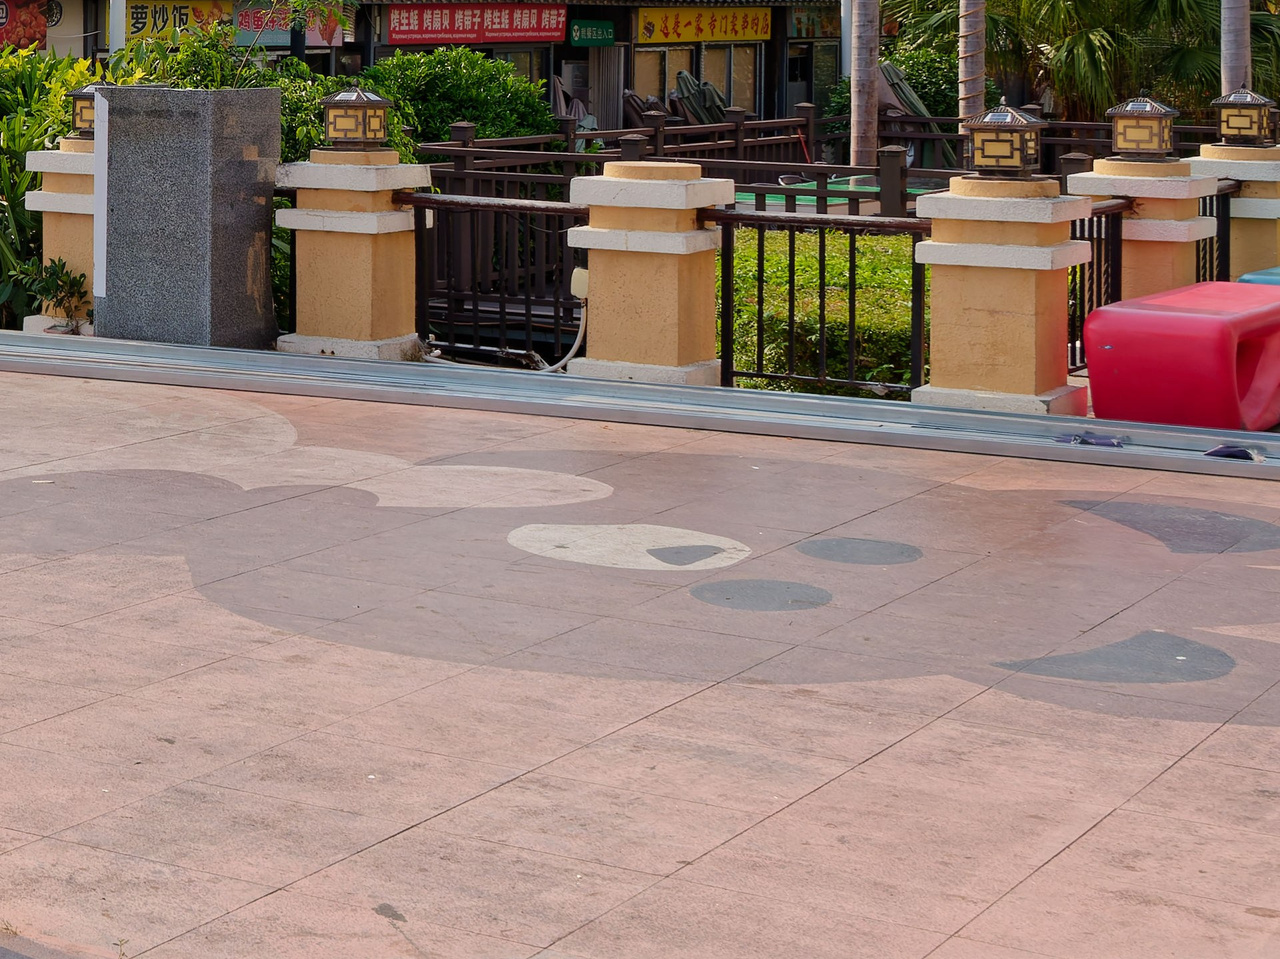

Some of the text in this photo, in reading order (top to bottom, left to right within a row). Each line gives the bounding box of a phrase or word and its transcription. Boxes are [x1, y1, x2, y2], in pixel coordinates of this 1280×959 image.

[126, 4, 190, 36] 萝炒饭
[423, 9, 450, 30] 烤扇贝
[454, 9, 481, 30] 烤带子
[513, 9, 537, 29] 烤扇贝
[542, 9, 566, 29] 烤带子
